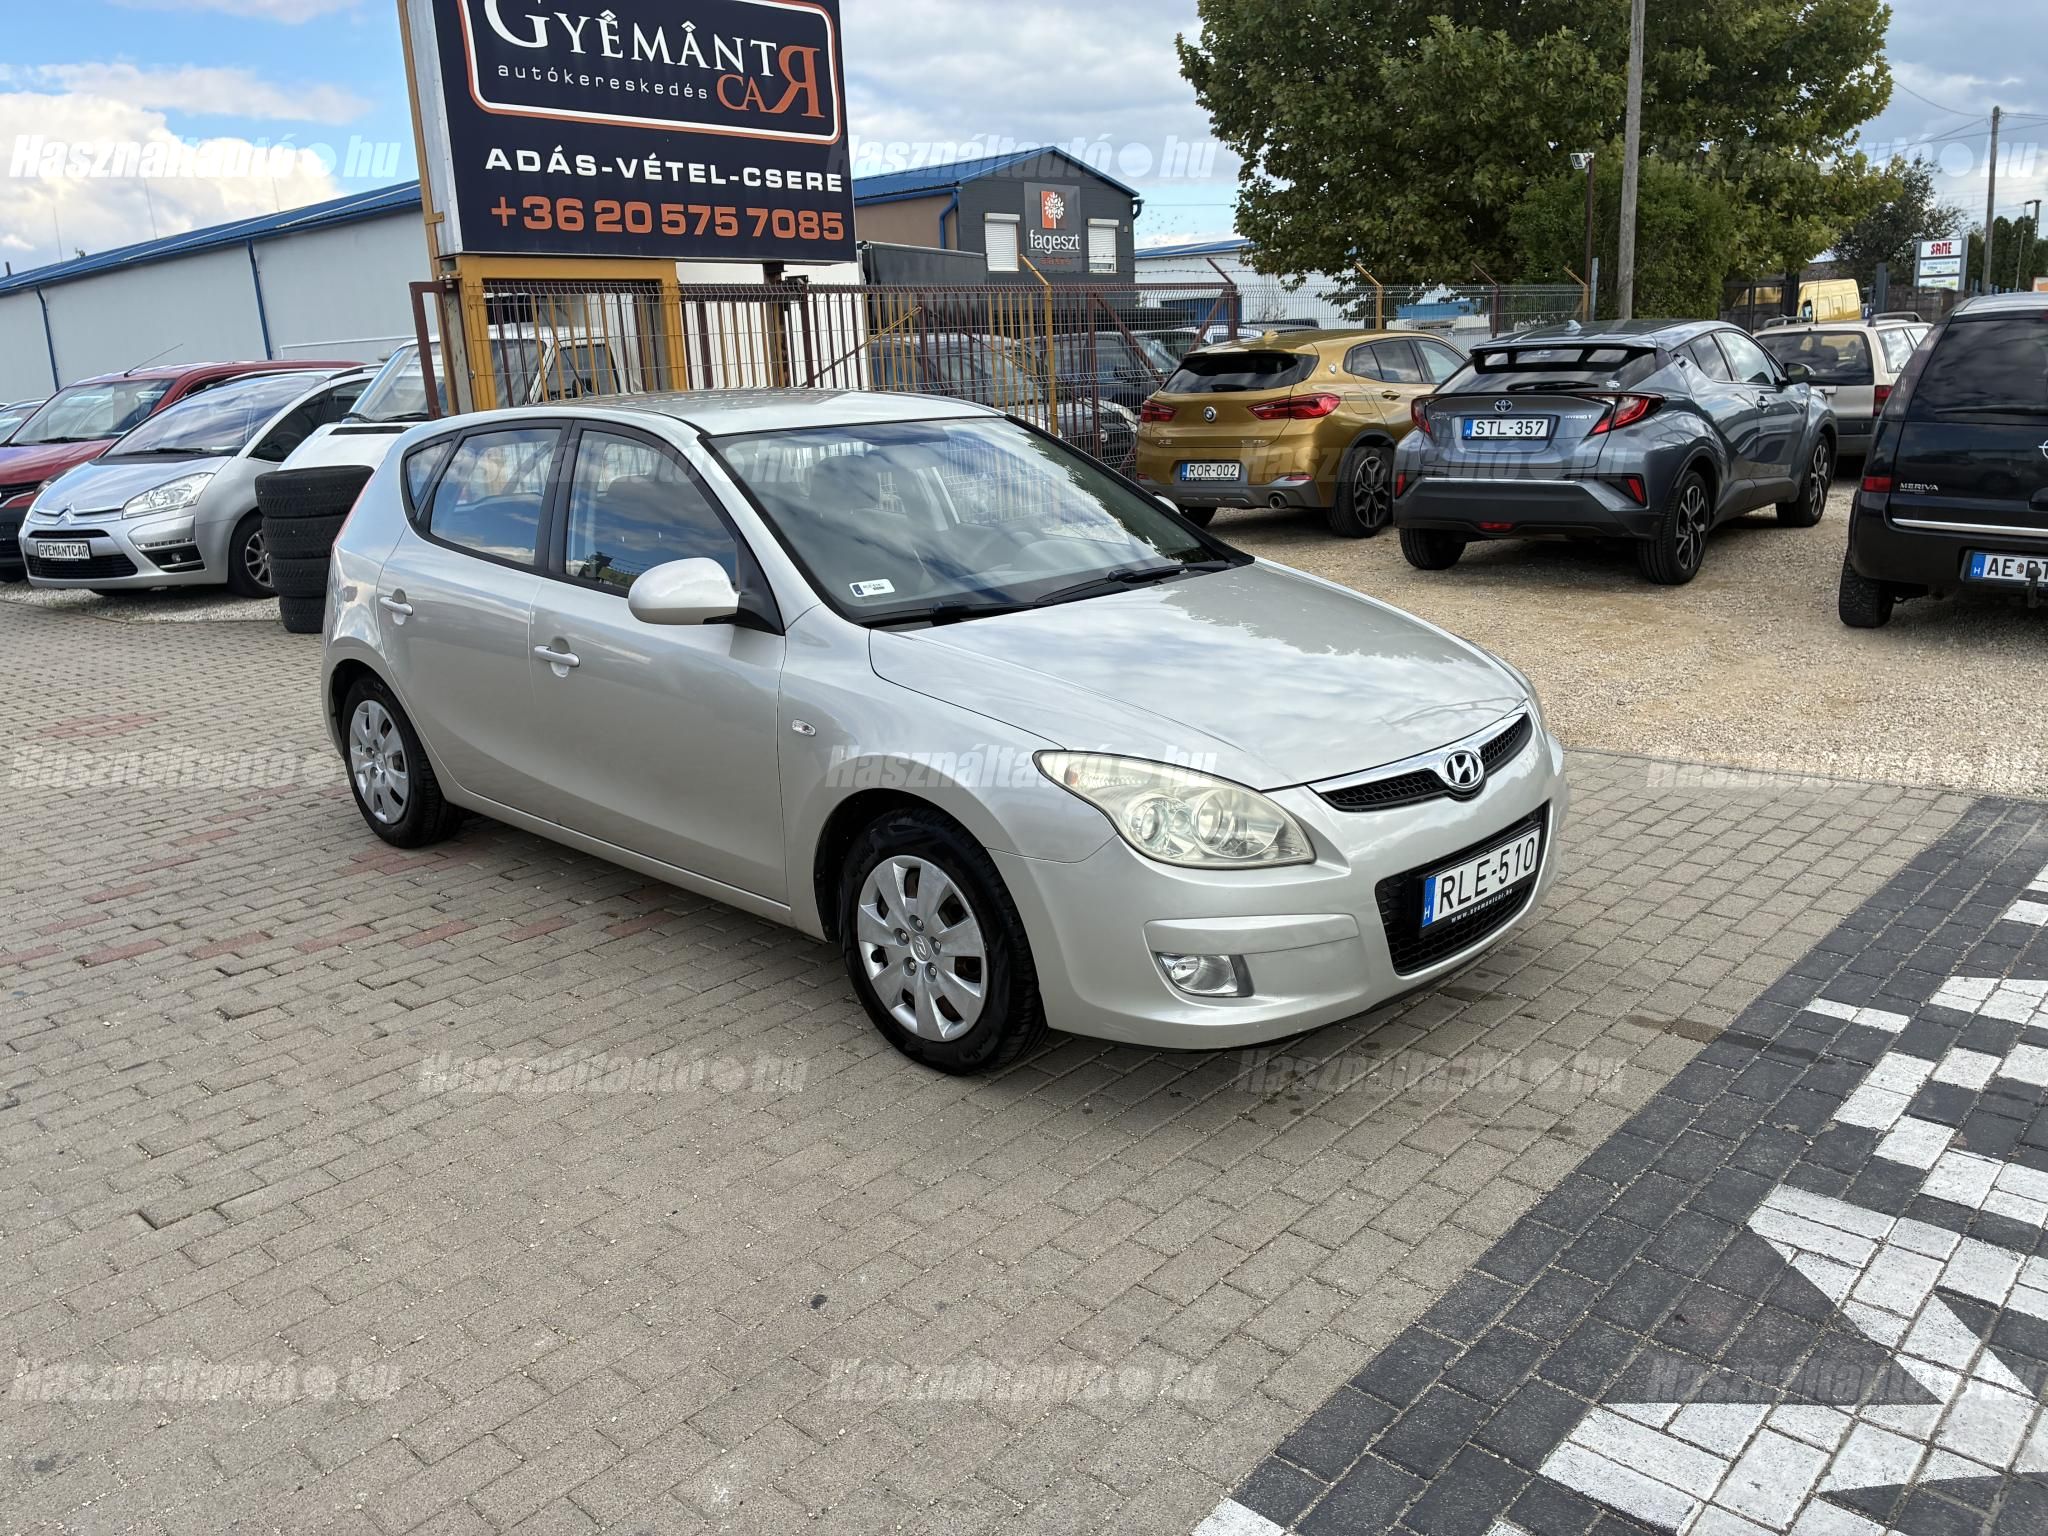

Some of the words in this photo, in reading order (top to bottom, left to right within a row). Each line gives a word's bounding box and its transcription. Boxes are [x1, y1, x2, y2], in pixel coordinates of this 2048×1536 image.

[498, 64, 708, 99] autókereskedés
[485, 145, 843, 193] ADÁS-VÉTEL-CSERE
[491, 196, 585, 232] +36
[594, 200, 653, 234] 20
[660, 203, 739, 238] 575
[746, 207, 844, 241] 7085
[1029, 229, 1080, 254] fageszt
[1931, 241, 1952, 255] SAME
[1475, 420, 1544, 435] STL-357
[1188, 464, 1236, 477] ROR-002
[1900, 482, 1939, 491] MERIVA
[39, 544, 89, 557] GYEMANTCAR
[1986, 557, 2015, 578] AE
[1439, 836, 1535, 914] RLE-510
